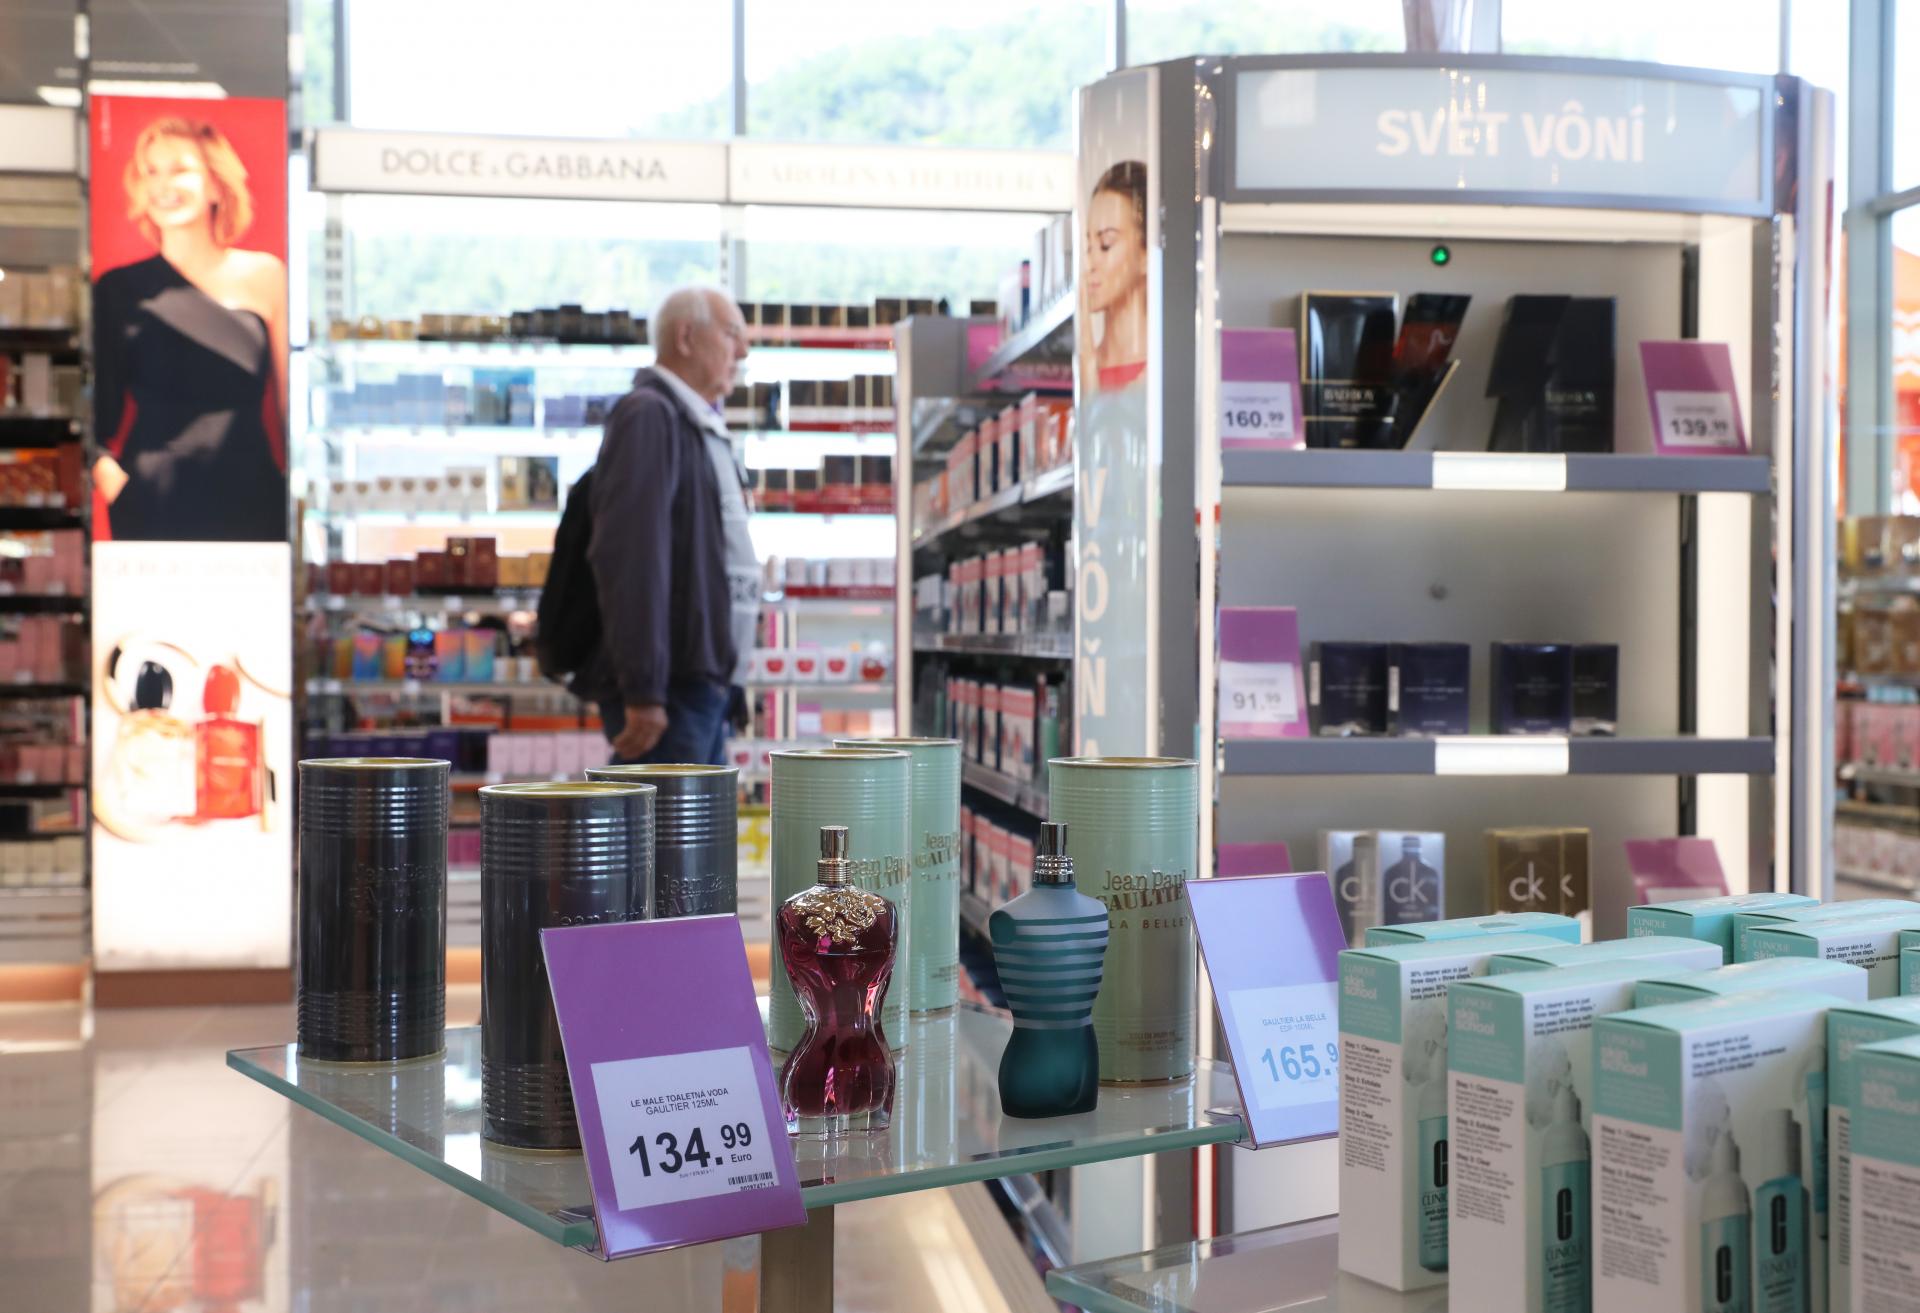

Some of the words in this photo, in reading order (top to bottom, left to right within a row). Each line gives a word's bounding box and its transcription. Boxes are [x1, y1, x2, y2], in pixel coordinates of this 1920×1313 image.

[1376, 108, 1510, 156] SVET
[1521, 99, 1645, 161] VÔNÍ
[381, 148, 483, 176] DOLCE
[506, 152, 667, 180] GABBANA
[1102, 870, 1147, 891] Jean
[1152, 869, 1187, 889] Paul
[1389, 862, 1428, 903] ck
[1509, 861, 1547, 902] ck
[1633, 918, 1667, 929] CLINIQUE
[1262, 1016, 1294, 1026] GAULTIER
[1296, 1015, 1304, 1023] LA
[1304, 1013, 1327, 1022] BELLE
[1262, 1042, 1338, 1082] 165.9
[630, 1099, 642, 1108] LE
[642, 1095, 665, 1107] MALE
[665, 1089, 706, 1103] TOALETNÁ
[706, 1087, 729, 1098] VODA
[645, 1101, 690, 1116] GAULTIER
[692, 1098, 719, 1109] 125ML
[731, 1152, 752, 1164] Euro
